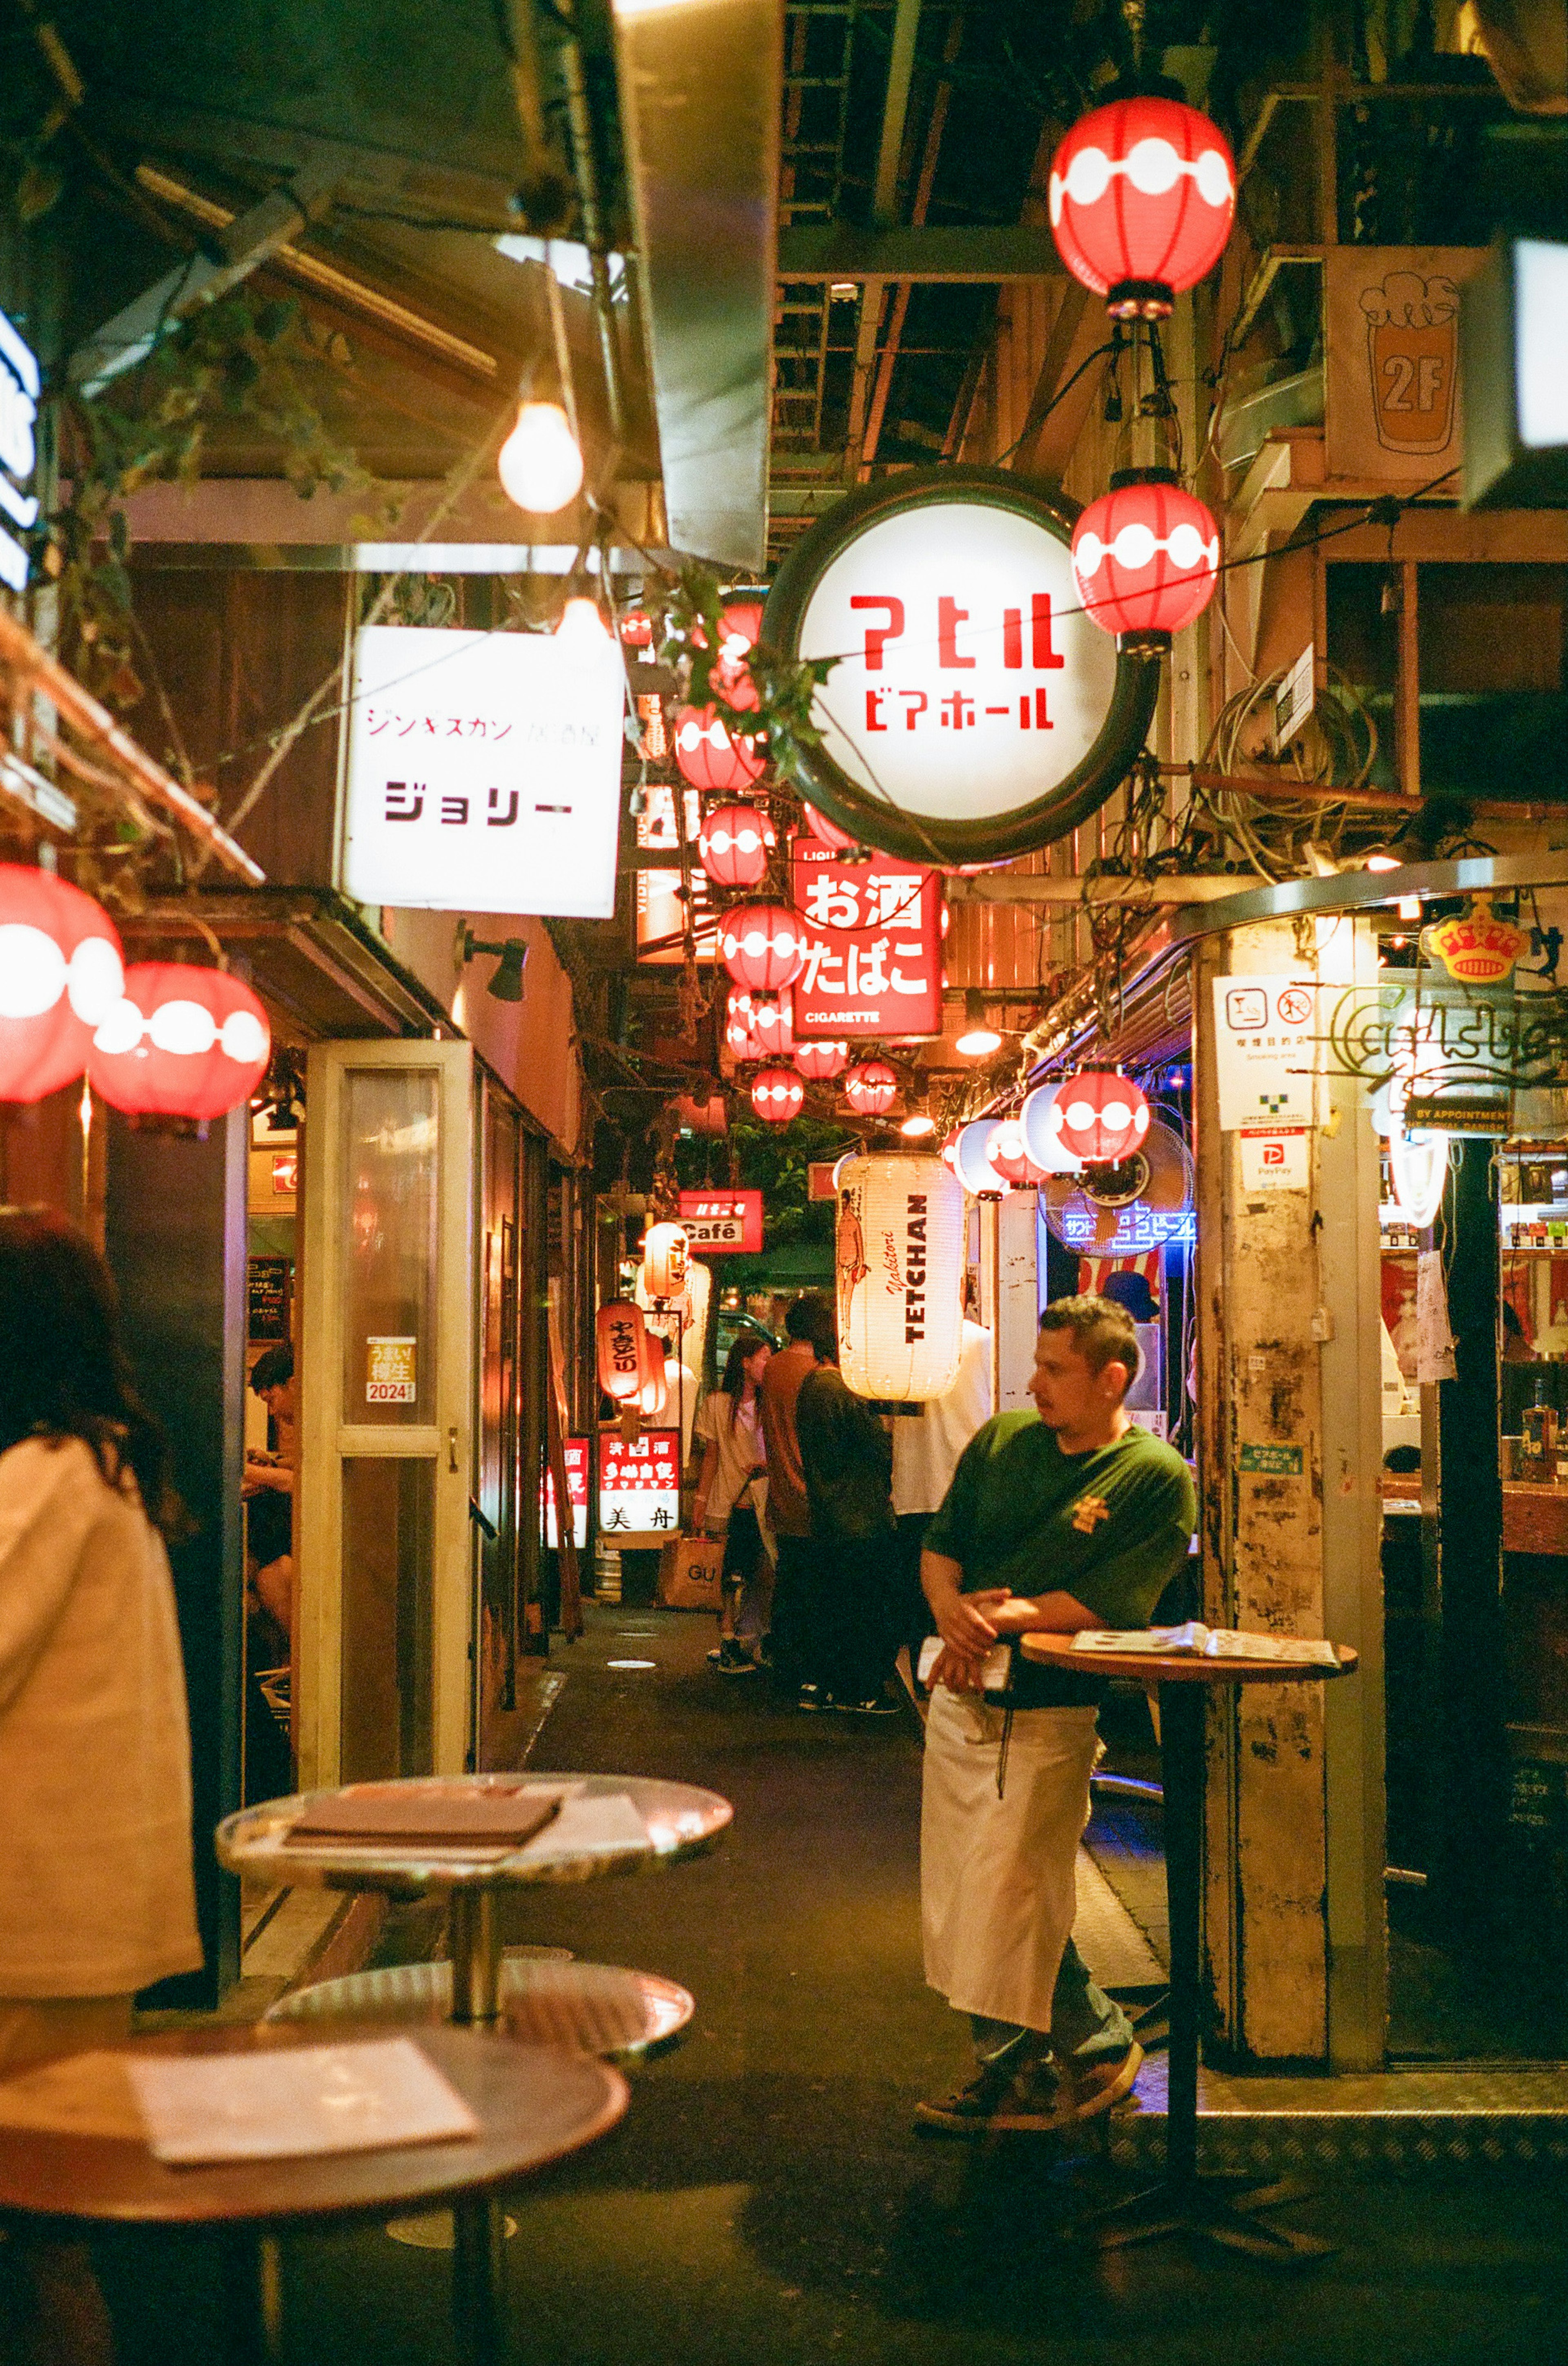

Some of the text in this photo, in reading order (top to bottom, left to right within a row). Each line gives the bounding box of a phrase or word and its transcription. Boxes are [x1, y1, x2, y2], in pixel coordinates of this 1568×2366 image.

[1383, 355, 1443, 412] 2F
[851, 593, 1064, 670] アヒル
[866, 687, 1054, 731] ビアホール
[385, 781, 572, 827] ジョリー
[804, 874, 923, 930] お酒
[802, 937, 927, 996] たばこ
[805, 1011, 880, 1024] CIGARETTE
[1417, 1109, 1432, 1118] BY
[1258, 1167, 1292, 1176] PayPay
[681, 1222, 735, 1240] Café
[885, 1230, 907, 1296] Yakitori
[905, 1195, 928, 1345] TETCHAN
[608, 1320, 637, 1371] やきとり
[370, 1384, 406, 1399] 2024
[606, 1507, 674, 1530] 美舟
[688, 1565, 715, 1582] GU
